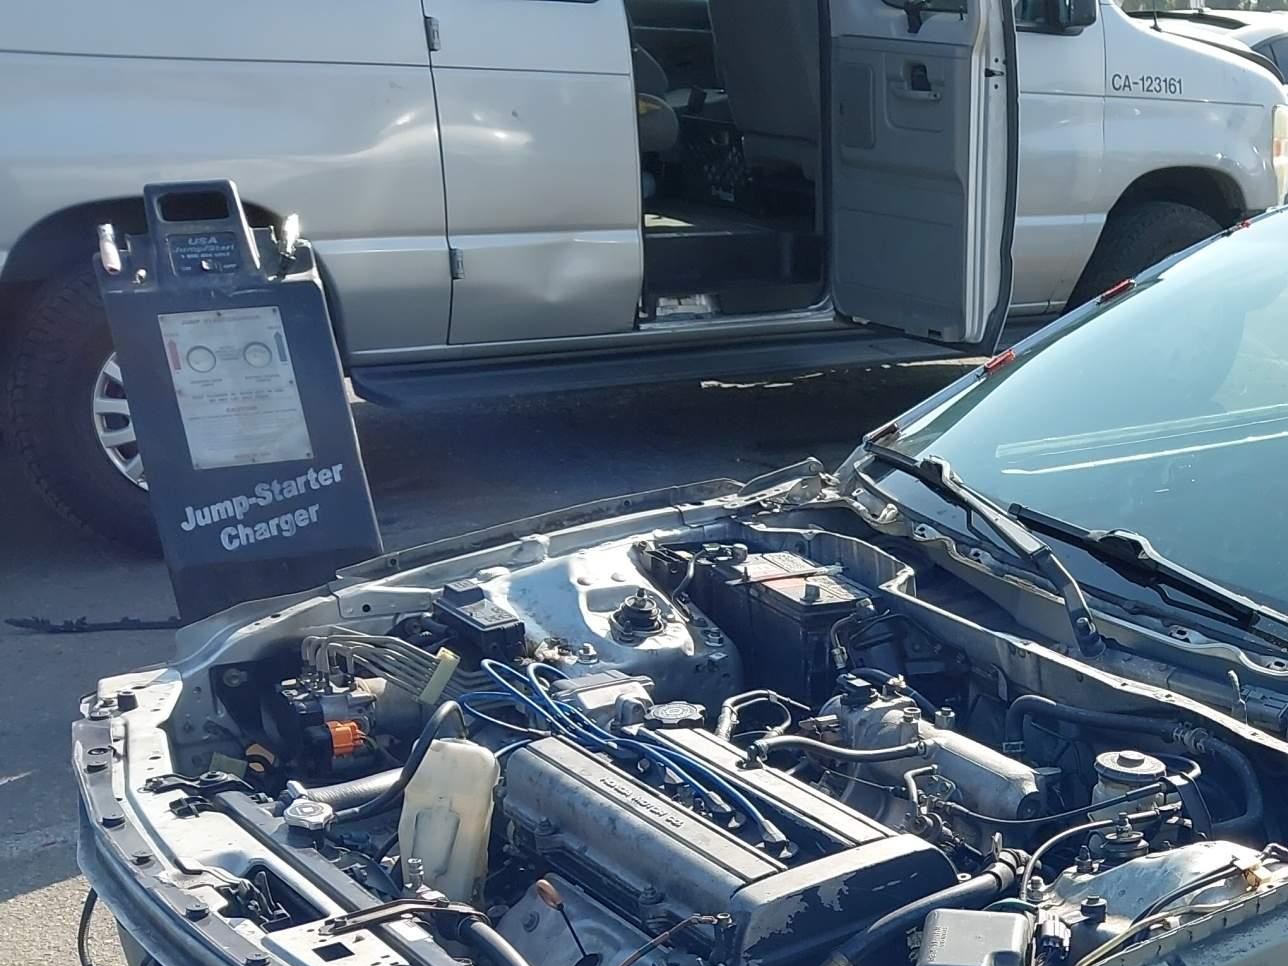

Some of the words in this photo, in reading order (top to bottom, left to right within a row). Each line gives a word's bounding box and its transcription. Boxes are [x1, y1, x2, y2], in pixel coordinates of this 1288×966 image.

[1111, 73, 1183, 95] CA-123161
[187, 236, 218, 246] USA
[180, 463, 343, 531] Jump-Starter
[220, 504, 320, 550] Charger
